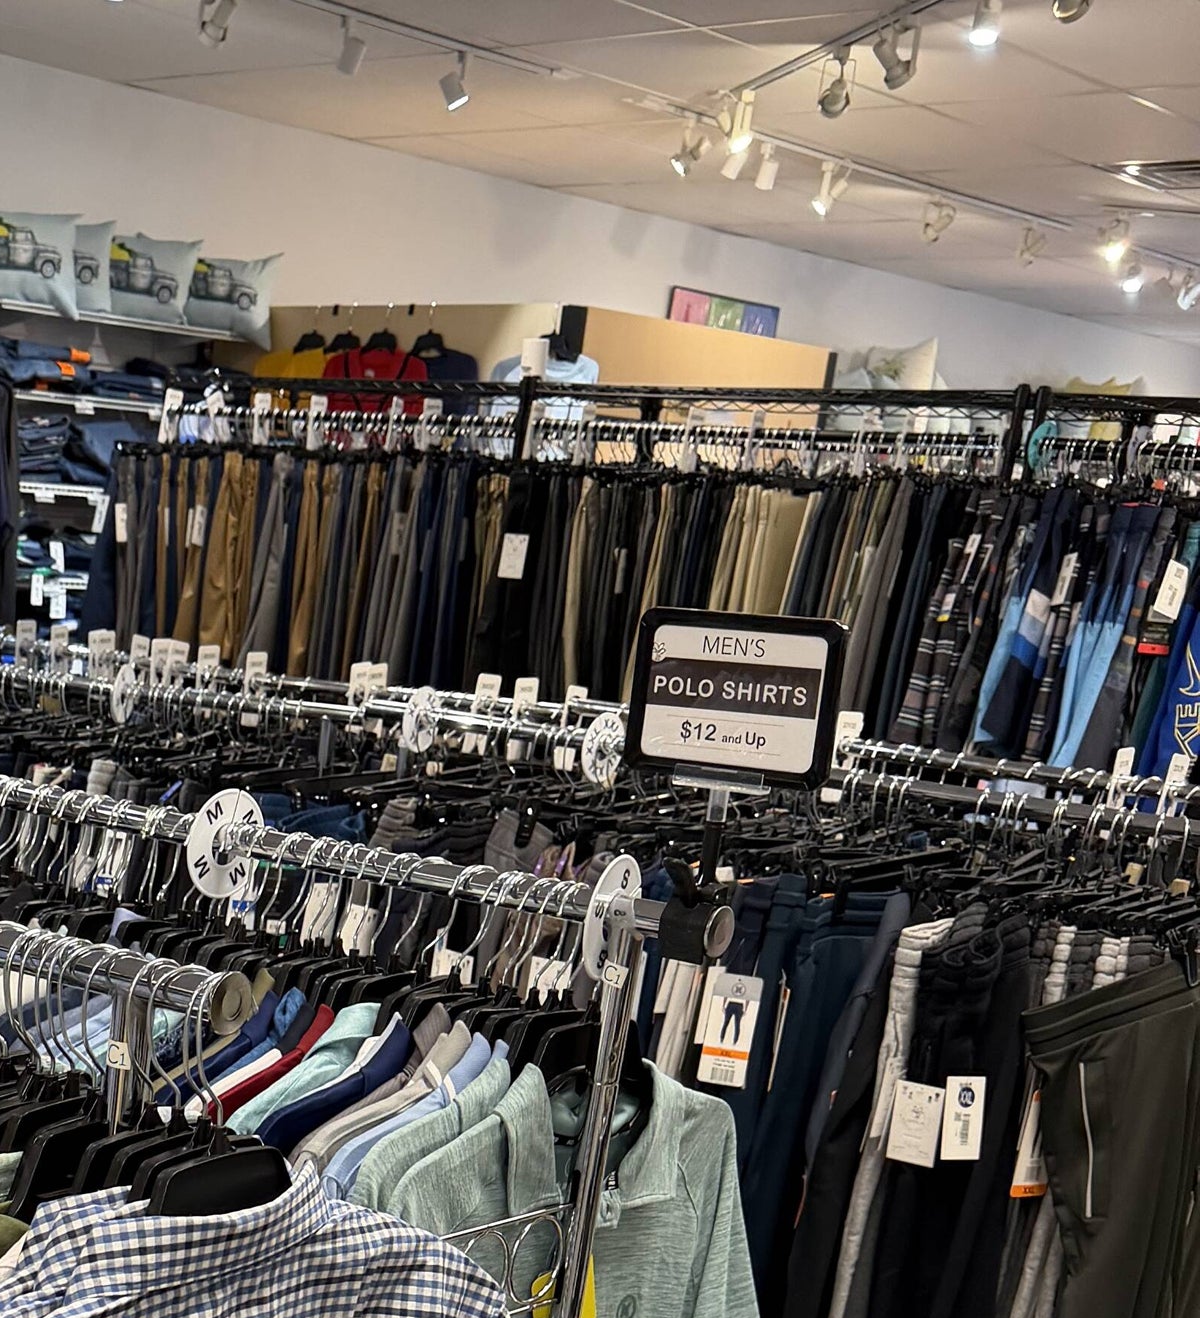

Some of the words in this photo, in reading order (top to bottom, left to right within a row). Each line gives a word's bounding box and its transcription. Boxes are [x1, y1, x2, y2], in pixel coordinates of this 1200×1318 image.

[702, 635, 767, 659] MEN'S
[653, 674, 714, 698] POLO
[722, 680, 808, 707] SHIRTS
[680, 719, 717, 743] $12
[721, 734, 742, 745] and
[745, 731, 767, 750] Up
[205, 800, 224, 825] M
[242, 808, 258, 825] M
[193, 854, 211, 880] M
[229, 862, 246, 886] M
[620, 868, 631, 890] S
[604, 964, 621, 985] C1
[107, 1043, 128, 1067] C1
